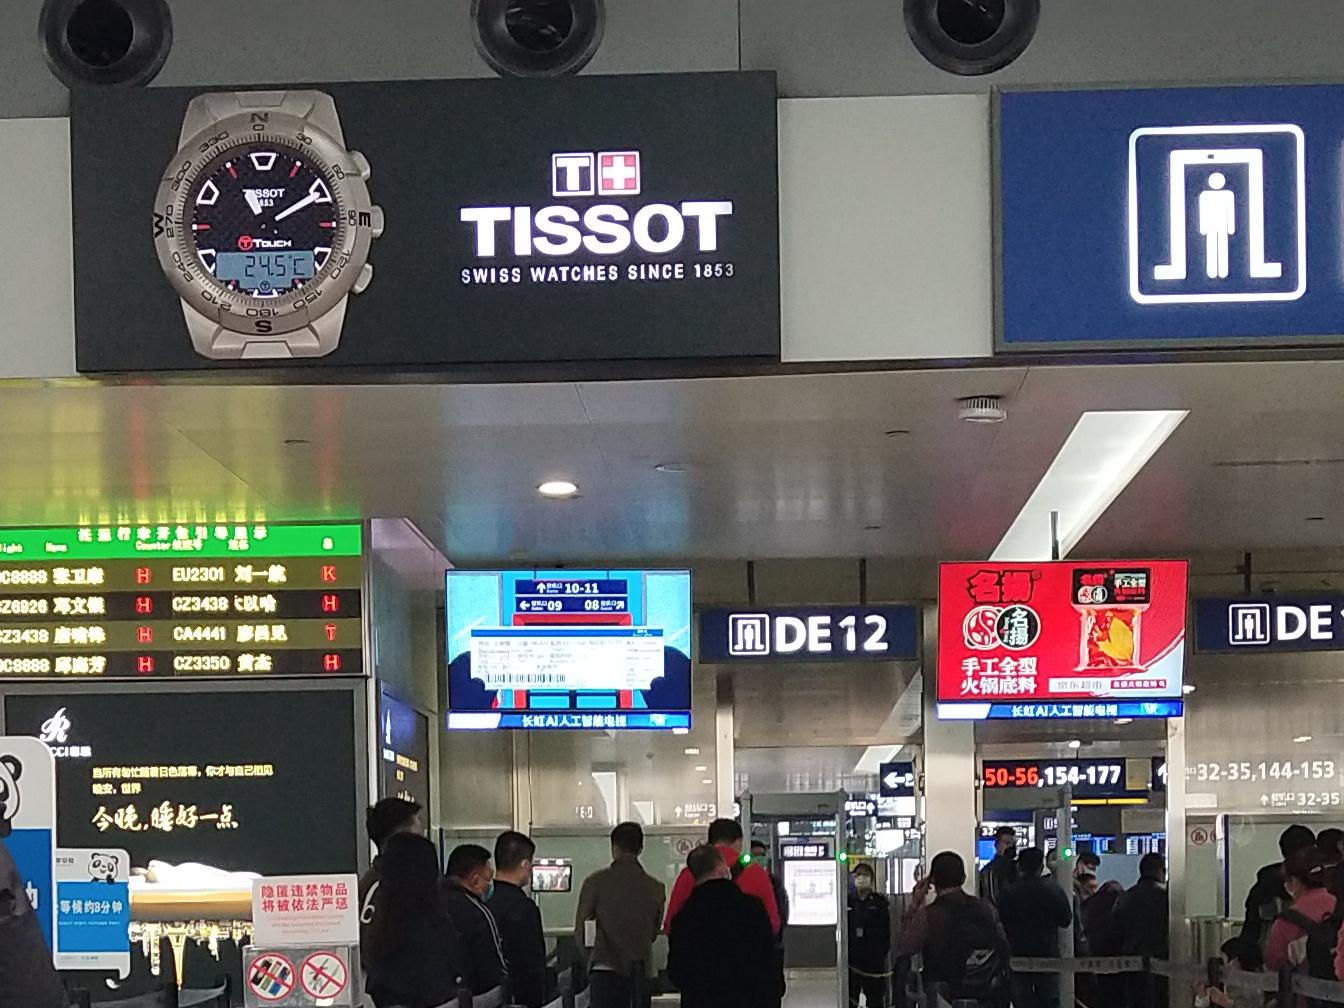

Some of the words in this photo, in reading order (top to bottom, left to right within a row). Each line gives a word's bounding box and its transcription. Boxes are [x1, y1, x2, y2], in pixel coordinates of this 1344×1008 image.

[199, 131, 230, 153] 330
[460, 201, 733, 257] TISSOT
[461, 268, 521, 284] SWISS
[531, 265, 618, 283] WATCHES
[628, 263, 684, 280] SINCE
[694, 263, 735, 278] 1853
[172, 567, 226, 583] EU2301
[565, 583, 600, 594] 10-11
[136, 597, 152, 614] H
[323, 595, 339, 611] H
[584, 599, 600, 611] 08
[137, 626, 153, 643] H
[775, 614, 889, 653] DE12
[138, 657, 154, 673] H
[324, 654, 340, 671] H
[960, 657, 1038, 676] 手工全型
[960, 676, 1038, 696] 火锅底料
[1011, 704, 1119, 717] 长虹AI人工智能电视
[261, 883, 348, 898] 隐匿违禁物品
[262, 897, 348, 912] 将被依法严惩
